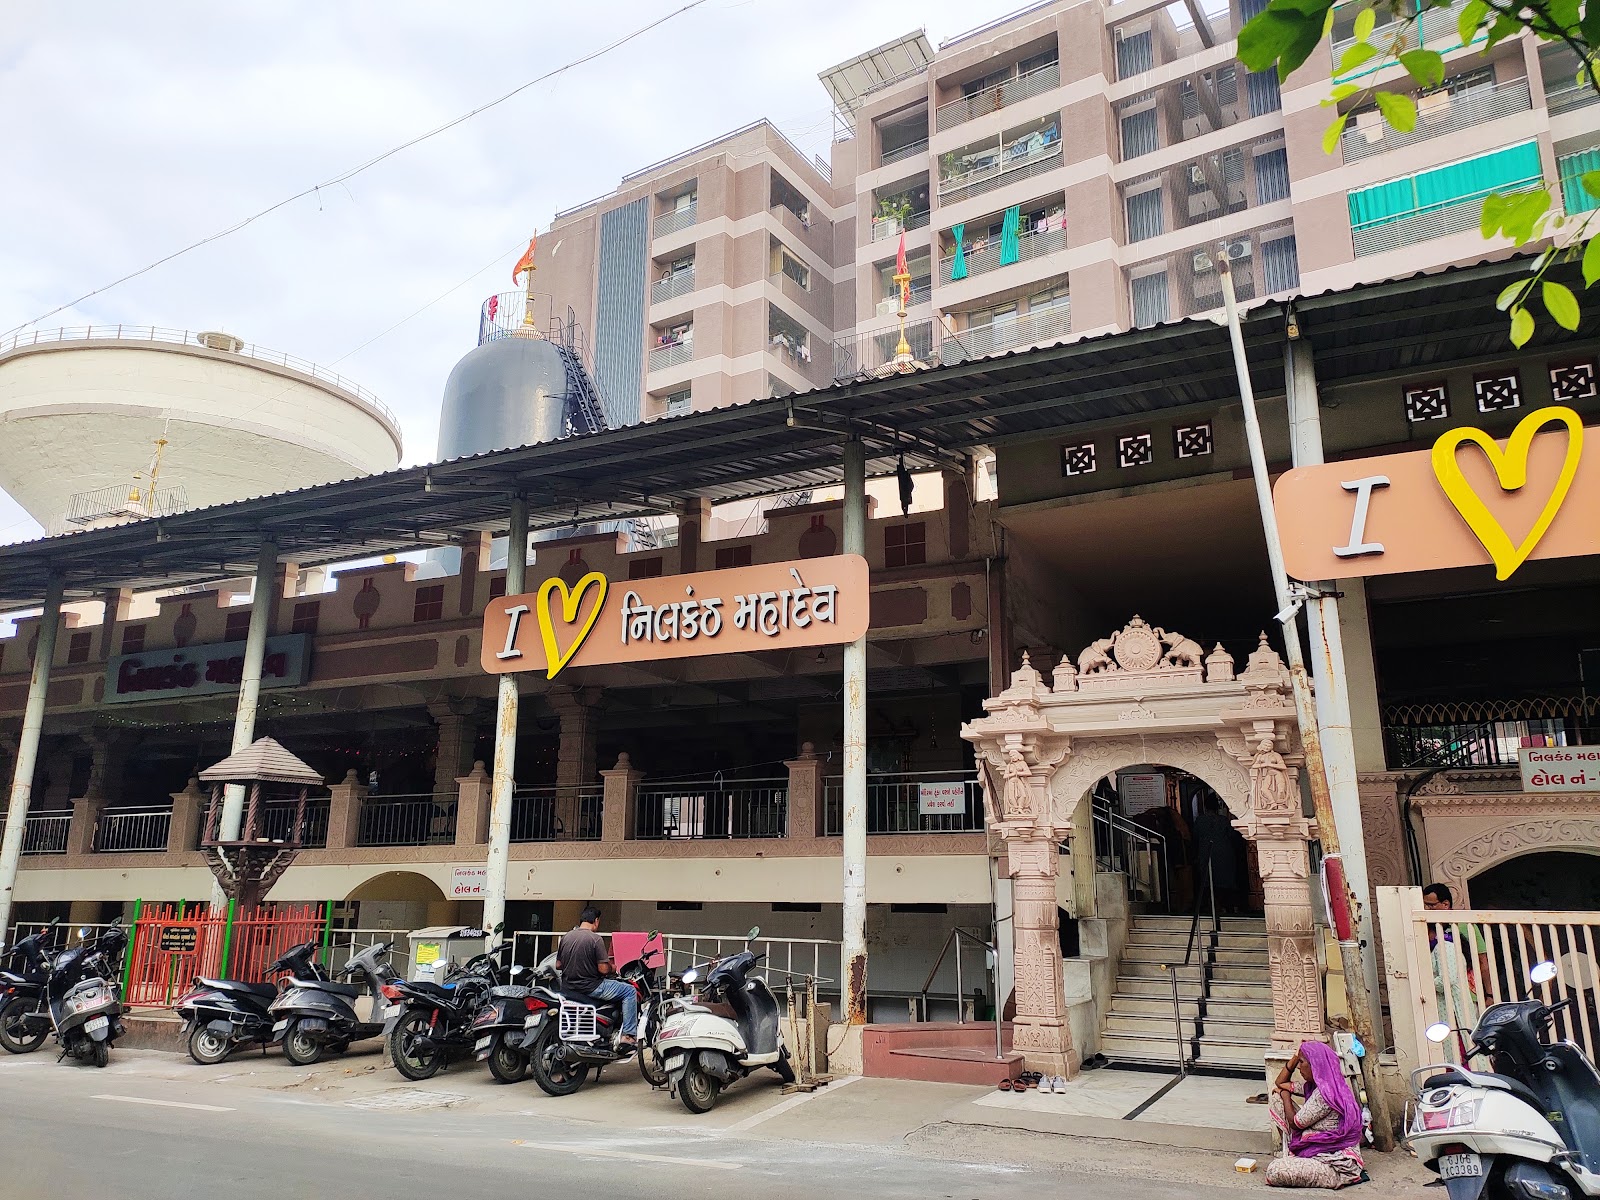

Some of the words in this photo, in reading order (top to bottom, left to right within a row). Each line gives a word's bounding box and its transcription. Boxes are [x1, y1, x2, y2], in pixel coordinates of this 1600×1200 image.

[1333, 475, 1391, 557] I
[496, 605, 530, 659] I
[733, 567, 839, 636] મહાદેવ
[1529, 751, 1572, 762] નિલકંઠ
[1531, 769, 1565, 786] હોલ
[454, 883, 471, 894] હોલ
